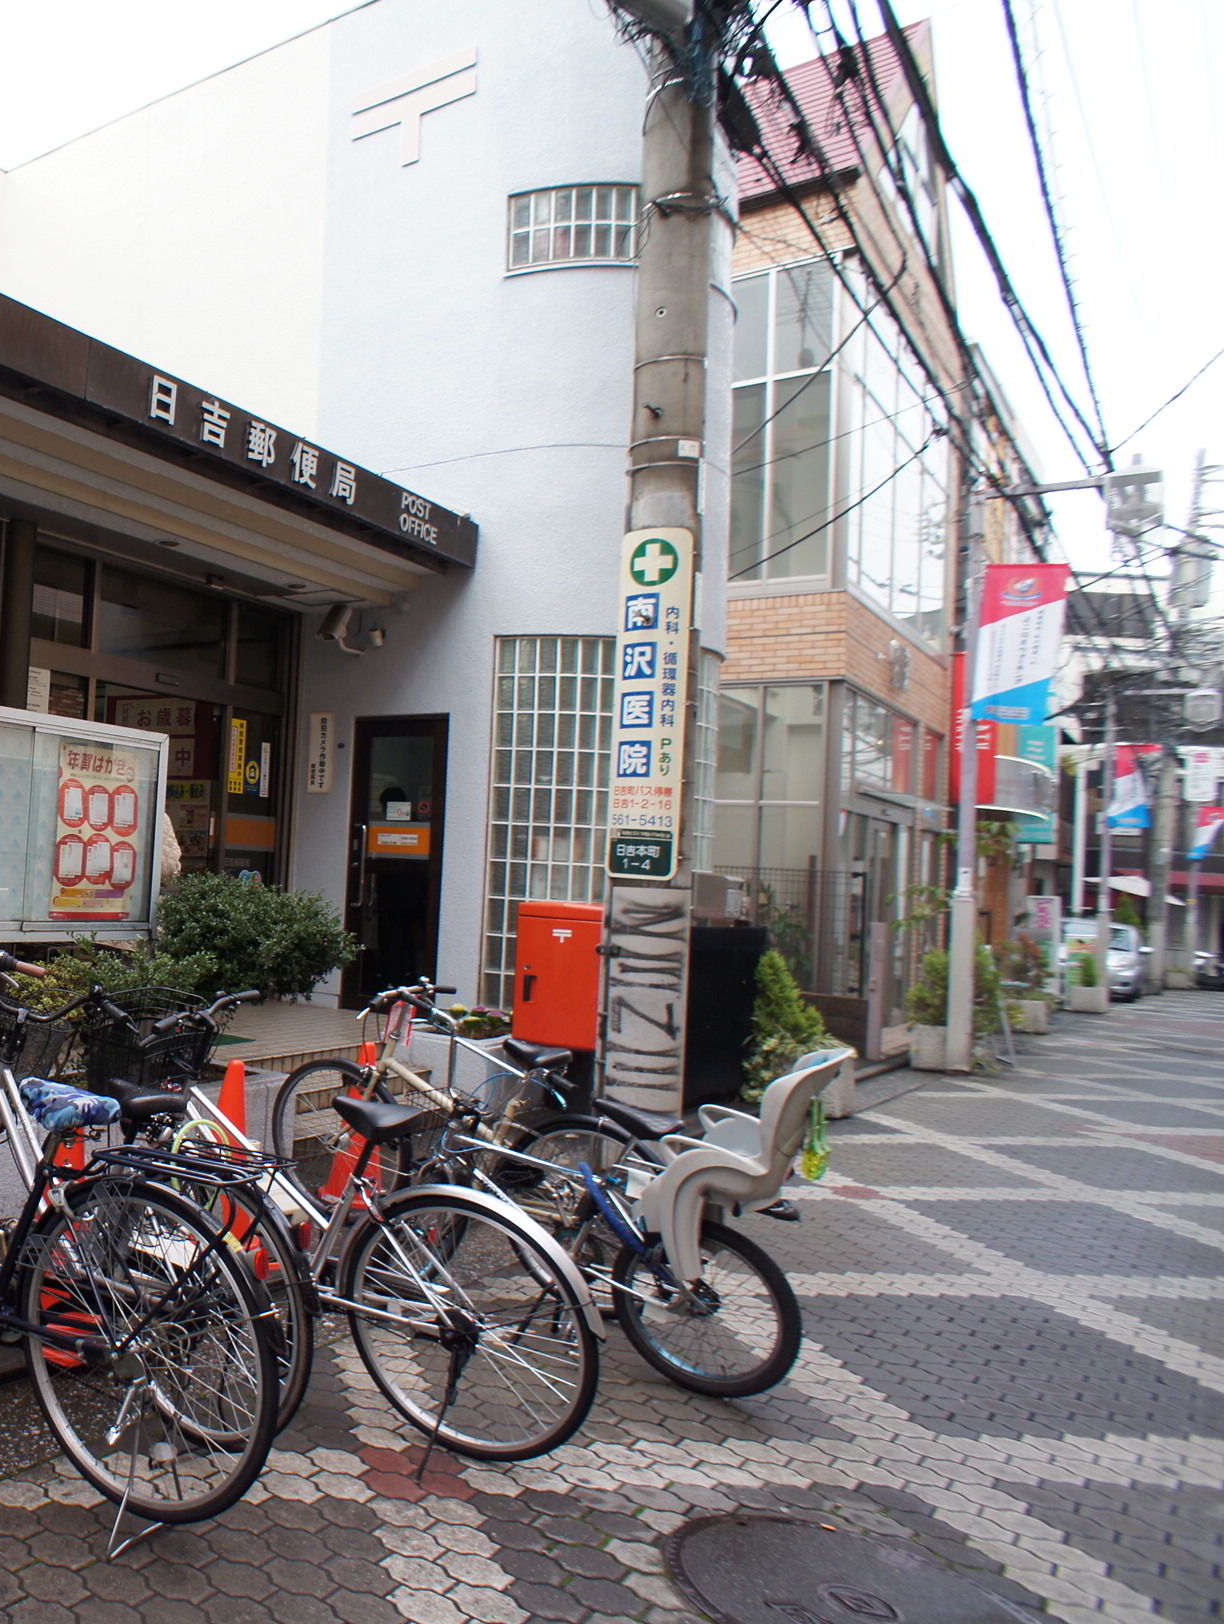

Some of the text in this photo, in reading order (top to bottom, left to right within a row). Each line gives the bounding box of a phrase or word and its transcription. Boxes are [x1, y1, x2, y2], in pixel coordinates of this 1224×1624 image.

[149, 374, 357, 506] 日吉郵便局
[401, 491, 432, 518] POST
[399, 514, 438, 546] OFFICE
[617, 595, 658, 777] 南沢医院
[659, 606, 680, 776] 内科・循環器内科 Pあり
[137, 706, 193, 728] お歳暮
[611, 813, 673, 828] 561-5413
[616, 844, 661, 858] 日吉本町
[622, 857, 652, 870] 1-4
